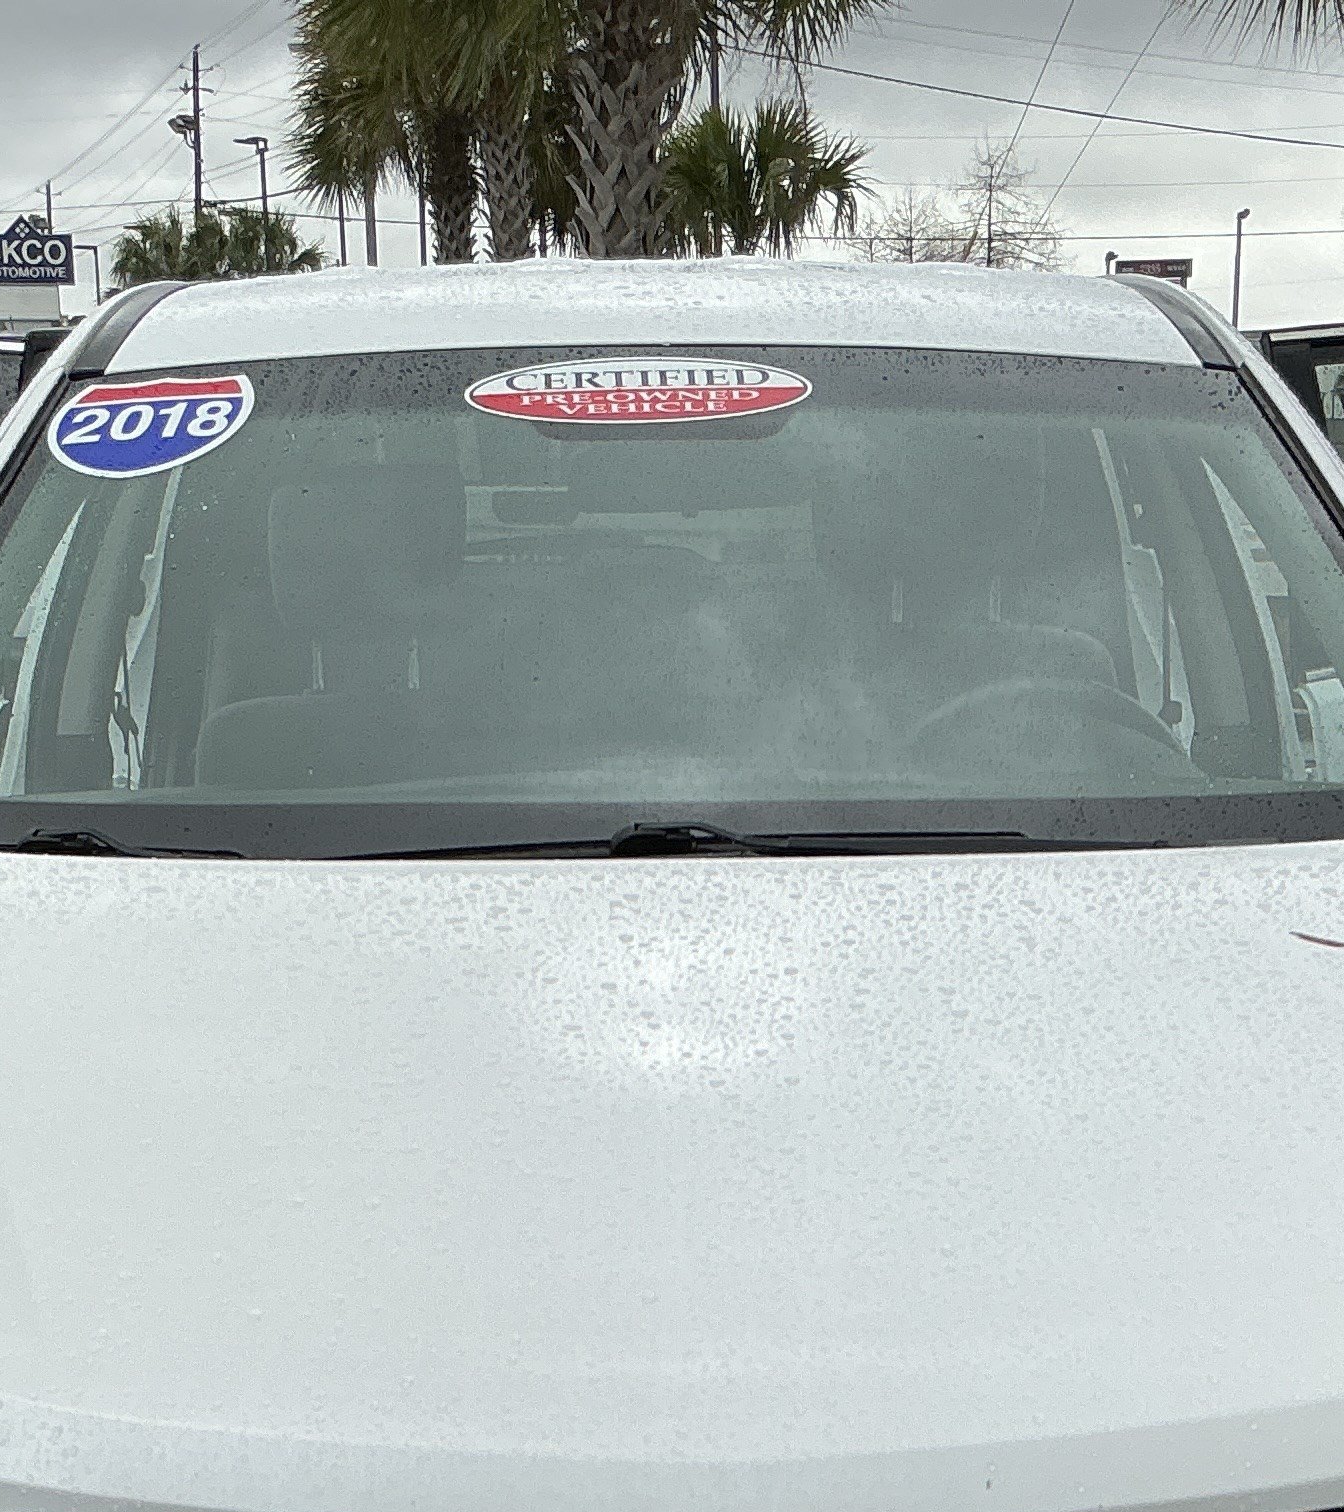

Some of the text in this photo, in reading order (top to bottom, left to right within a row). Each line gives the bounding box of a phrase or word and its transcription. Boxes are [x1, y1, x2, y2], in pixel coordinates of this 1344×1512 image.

[505, 368, 771, 391] CERTIFIED
[519, 389, 761, 406] PRE-OWNED
[557, 401, 728, 415] VEHICLE
[61, 400, 234, 446] 2018
